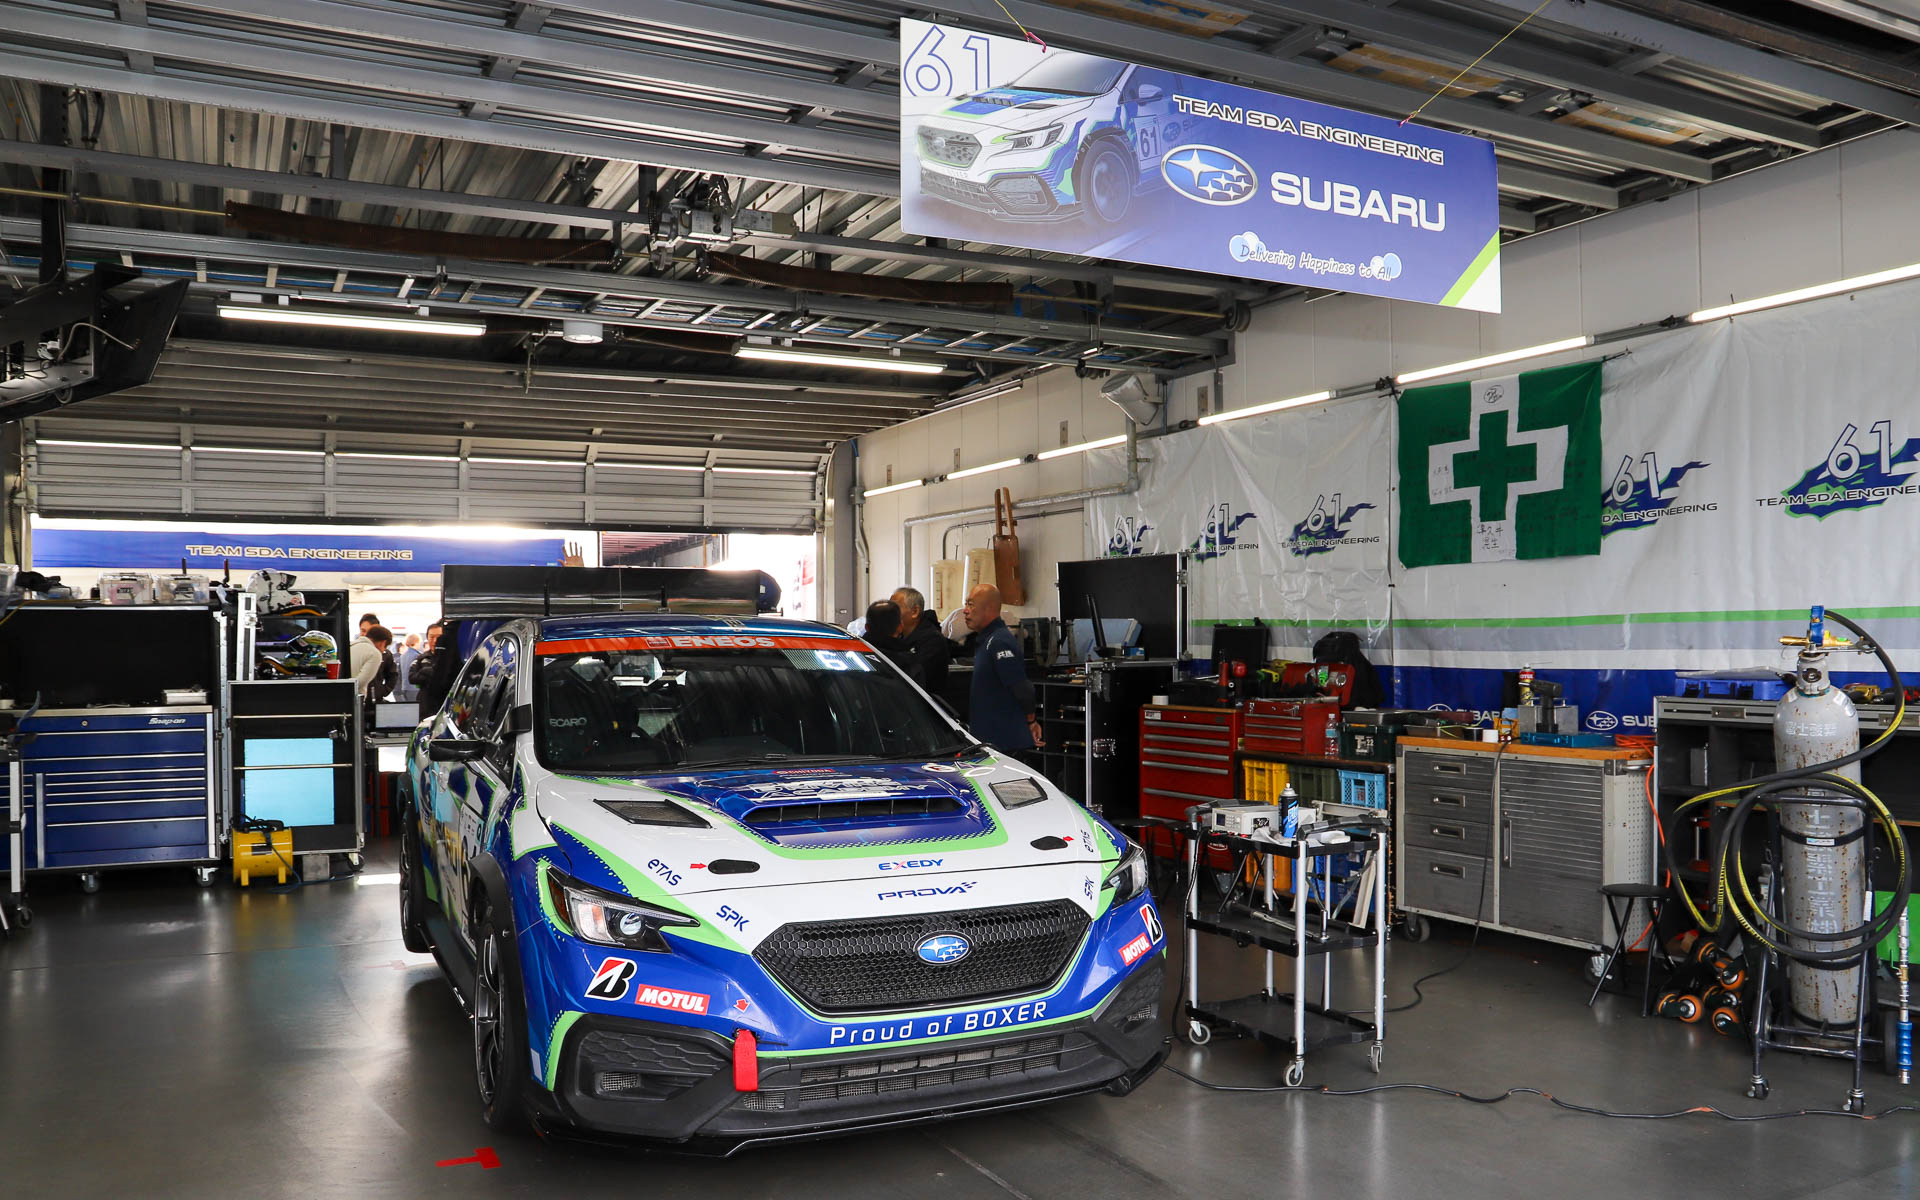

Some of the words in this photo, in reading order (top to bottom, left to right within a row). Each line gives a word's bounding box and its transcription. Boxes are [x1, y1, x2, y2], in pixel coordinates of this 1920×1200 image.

[903, 25, 990, 97] 61
[1140, 126, 1158, 158] 61
[1173, 94, 1243, 125] TEAM
[1246, 111, 1299, 136] SDA
[1300, 120, 1444, 165] ENGINEERING
[1270, 171, 1446, 232] SUBARU
[1239, 244, 1295, 268] Delivering
[1300, 252, 1355, 277] Happiness
[1359, 262, 1372, 277] to
[1377, 265, 1392, 279] All
[1828, 420, 1892, 479] 61
[1612, 452, 1661, 503] 61
[1756, 495, 1803, 507] TEAM
[1806, 492, 1842, 504] SDA
[1846, 484, 1920, 499] ENGINE
[1307, 493, 1342, 533] 61
[1602, 514, 1621, 522] DA
[1624, 502, 1718, 521] ENGINEERING
[186, 545, 241, 556] TEAM
[244, 546, 288, 558] SDA
[288, 548, 413, 560] ENGINEERING
[1316, 536, 1380, 547] ENGINEERING
[674, 637, 775, 648] ENEOS
[815, 650, 871, 672] 61
[549, 717, 587, 727] ECARO
[878, 859, 943, 870] EXEDY
[877, 884, 970, 901] PROVA
[1084, 876, 1095, 900] SPK
[716, 905, 750, 932] SPK
[1122, 936, 1150, 963] MOTUL
[639, 988, 704, 1012] MOTUL
[830, 1020, 913, 1044] Proud
[927, 1016, 952, 1035] of
[964, 1001, 1047, 1030] BOXER
